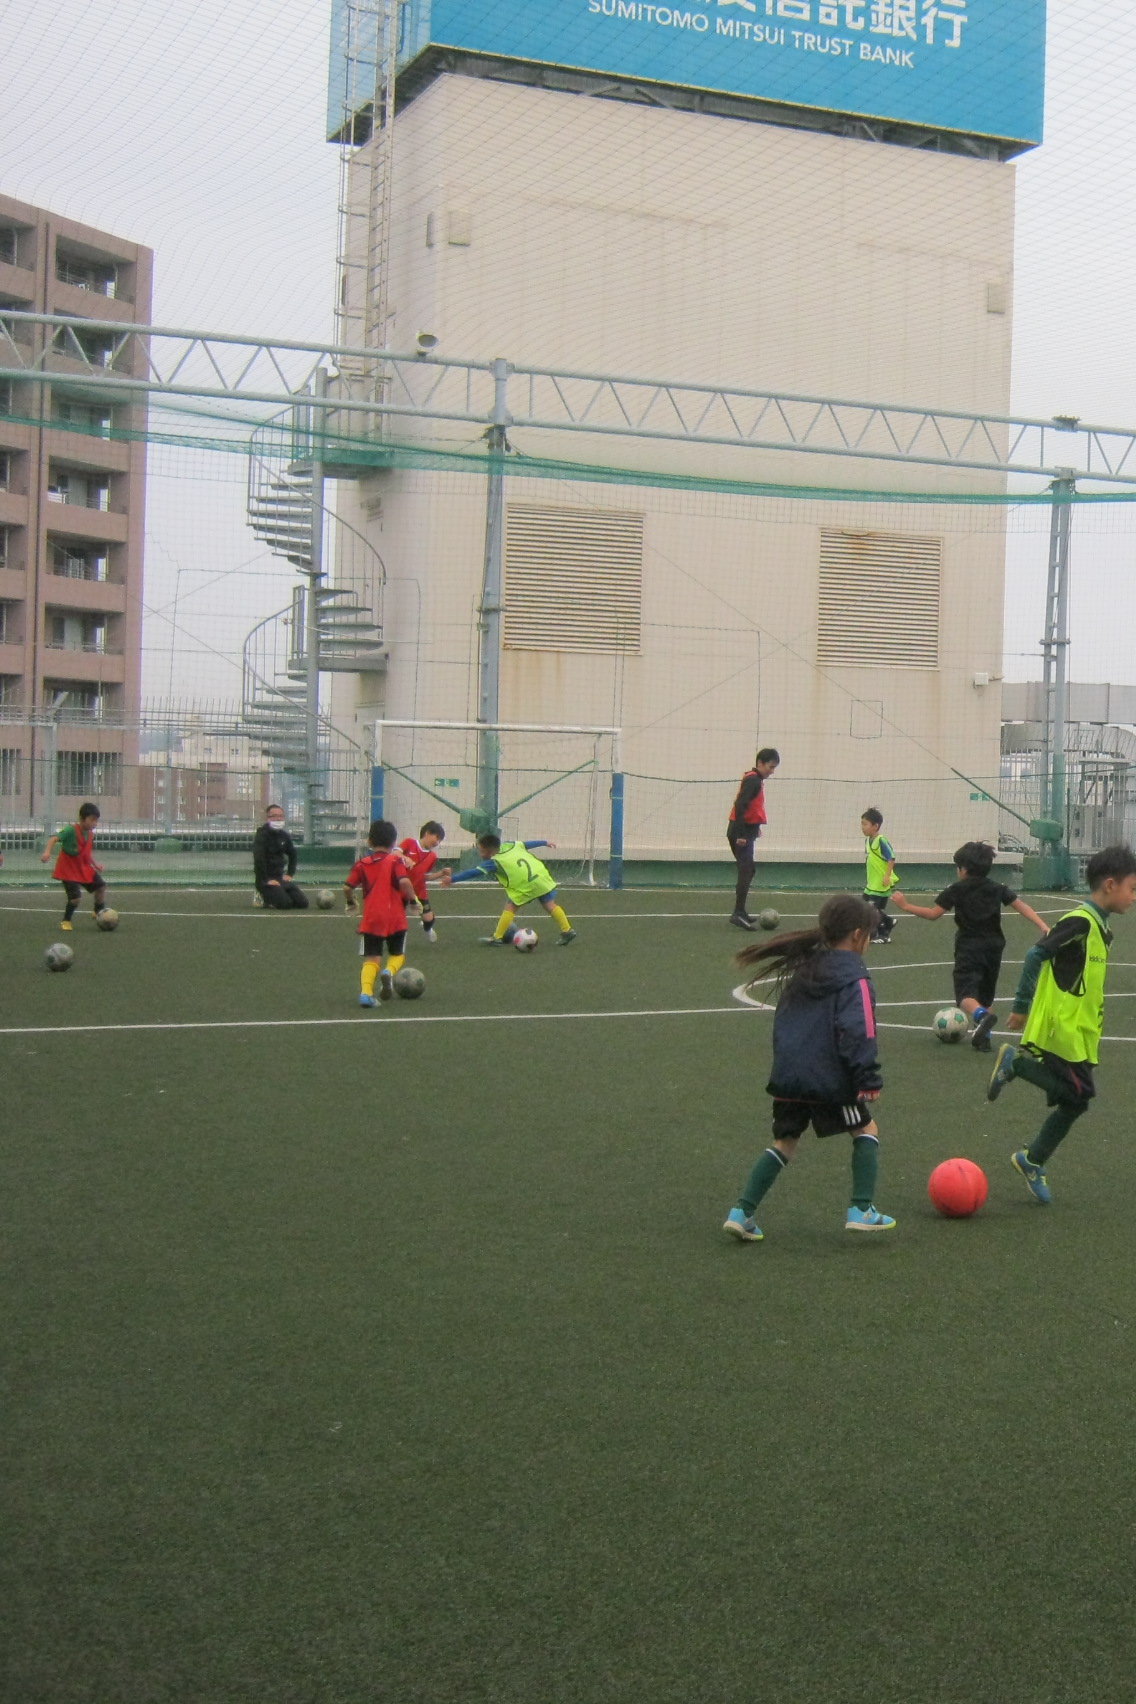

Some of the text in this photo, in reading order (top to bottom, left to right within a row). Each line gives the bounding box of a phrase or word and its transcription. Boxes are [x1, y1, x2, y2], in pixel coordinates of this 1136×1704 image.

[588, 0, 915, 68] SUMITOMO MITSUI TRUST BANK
[516, 858, 540, 883] 2
